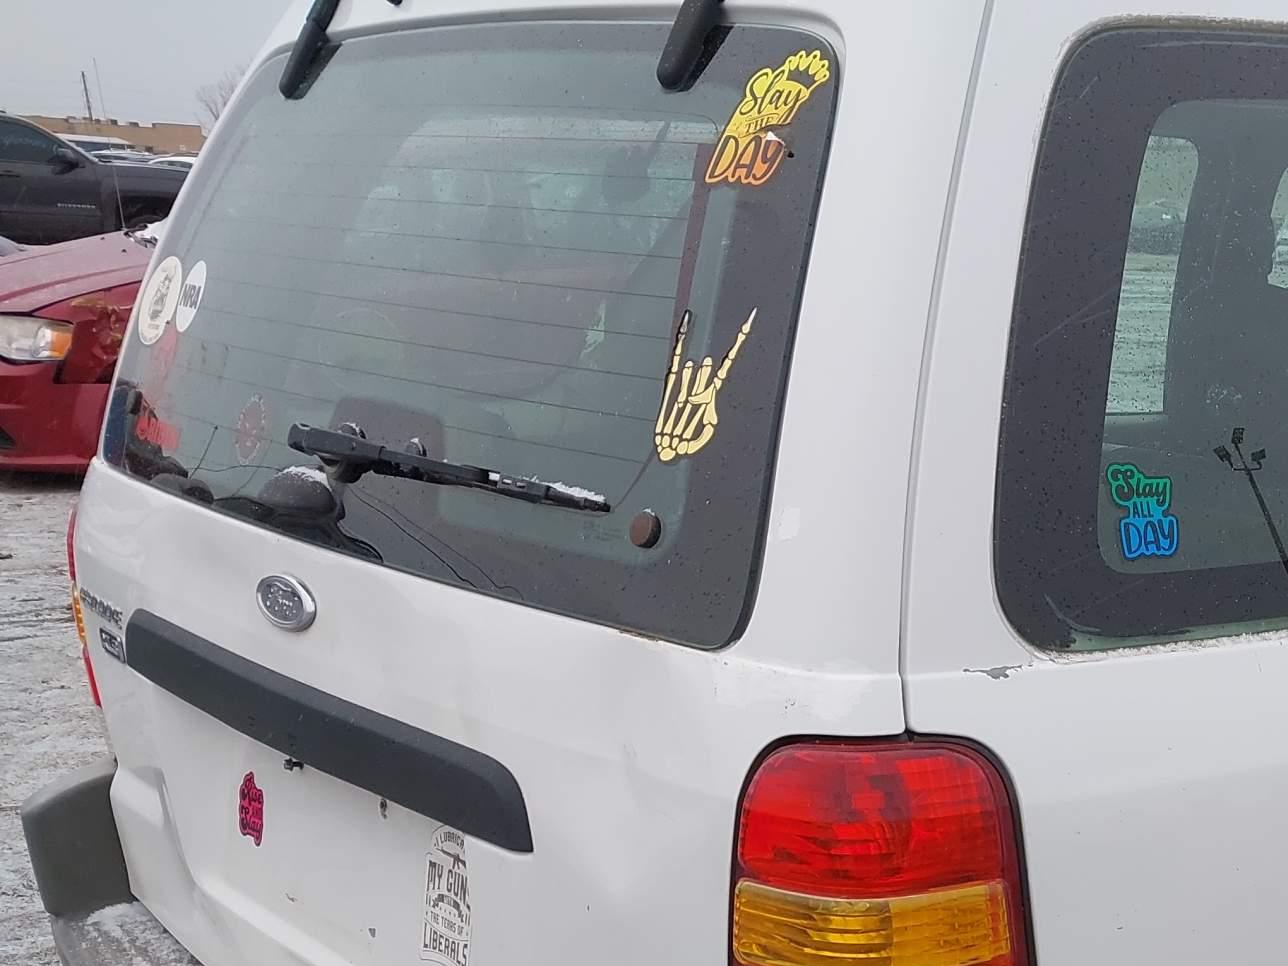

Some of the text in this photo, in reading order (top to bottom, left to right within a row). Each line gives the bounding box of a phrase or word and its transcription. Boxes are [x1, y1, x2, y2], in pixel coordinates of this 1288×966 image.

[740, 68, 809, 124] Slay
[706, 134, 784, 182] DAY
[179, 283, 202, 310] NRA
[1110, 468, 1168, 507] Slay
[1132, 501, 1154, 518] ALL
[1123, 518, 1175, 555] DAY
[426, 860, 444, 892] MY
[430, 910, 440, 925] THE
